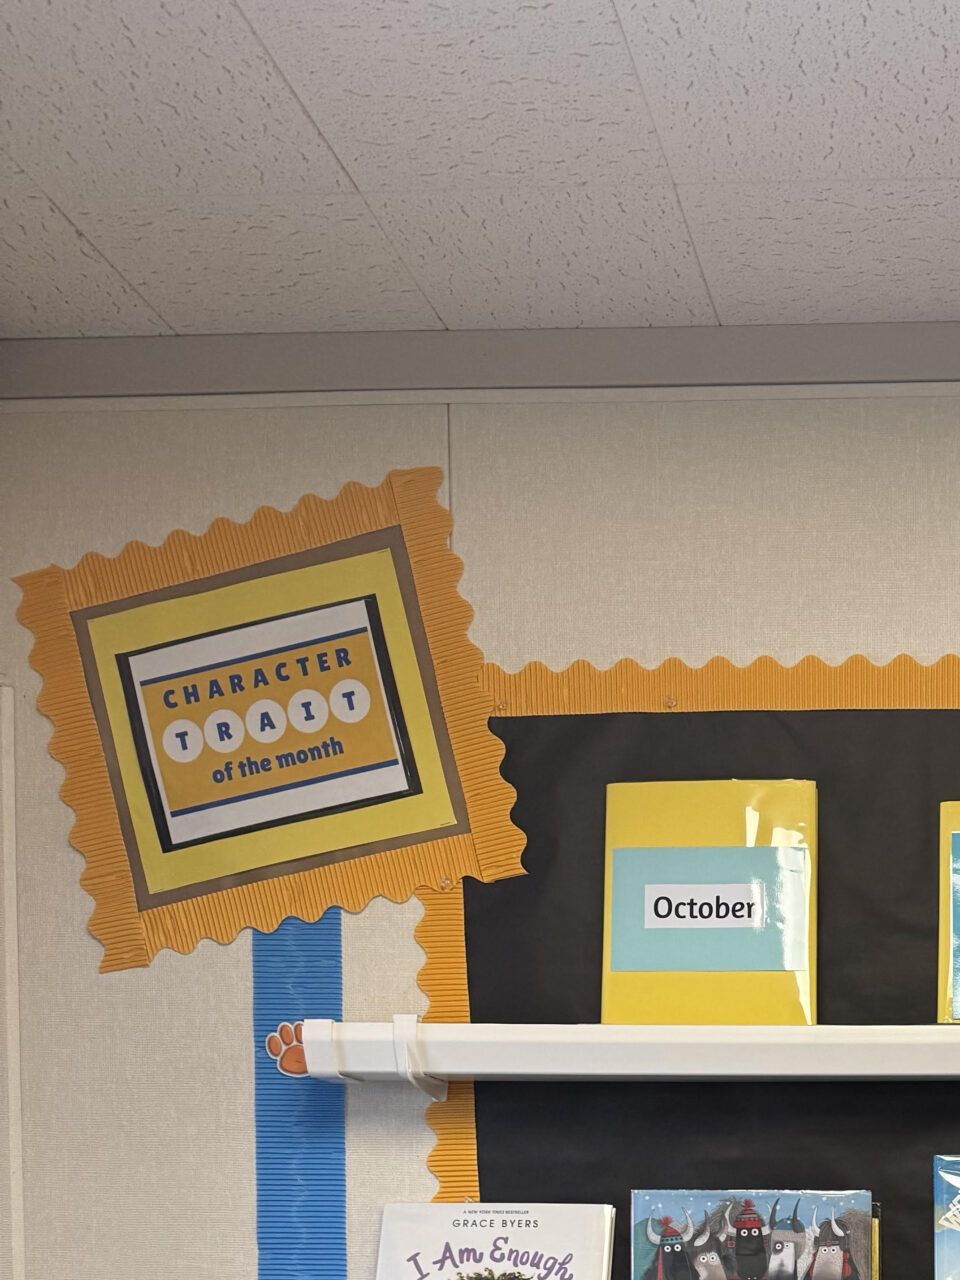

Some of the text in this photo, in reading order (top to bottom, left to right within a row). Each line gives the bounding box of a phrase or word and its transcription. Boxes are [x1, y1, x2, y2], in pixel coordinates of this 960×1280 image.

[163, 647, 352, 709] CHARACTER
[175, 690, 356, 751] TRAIT
[212, 736, 345, 784] of the month
[653, 895, 755, 919] October
[452, 1219, 540, 1228] GRACE BYERS
[432, 1241, 484, 1272] Am
